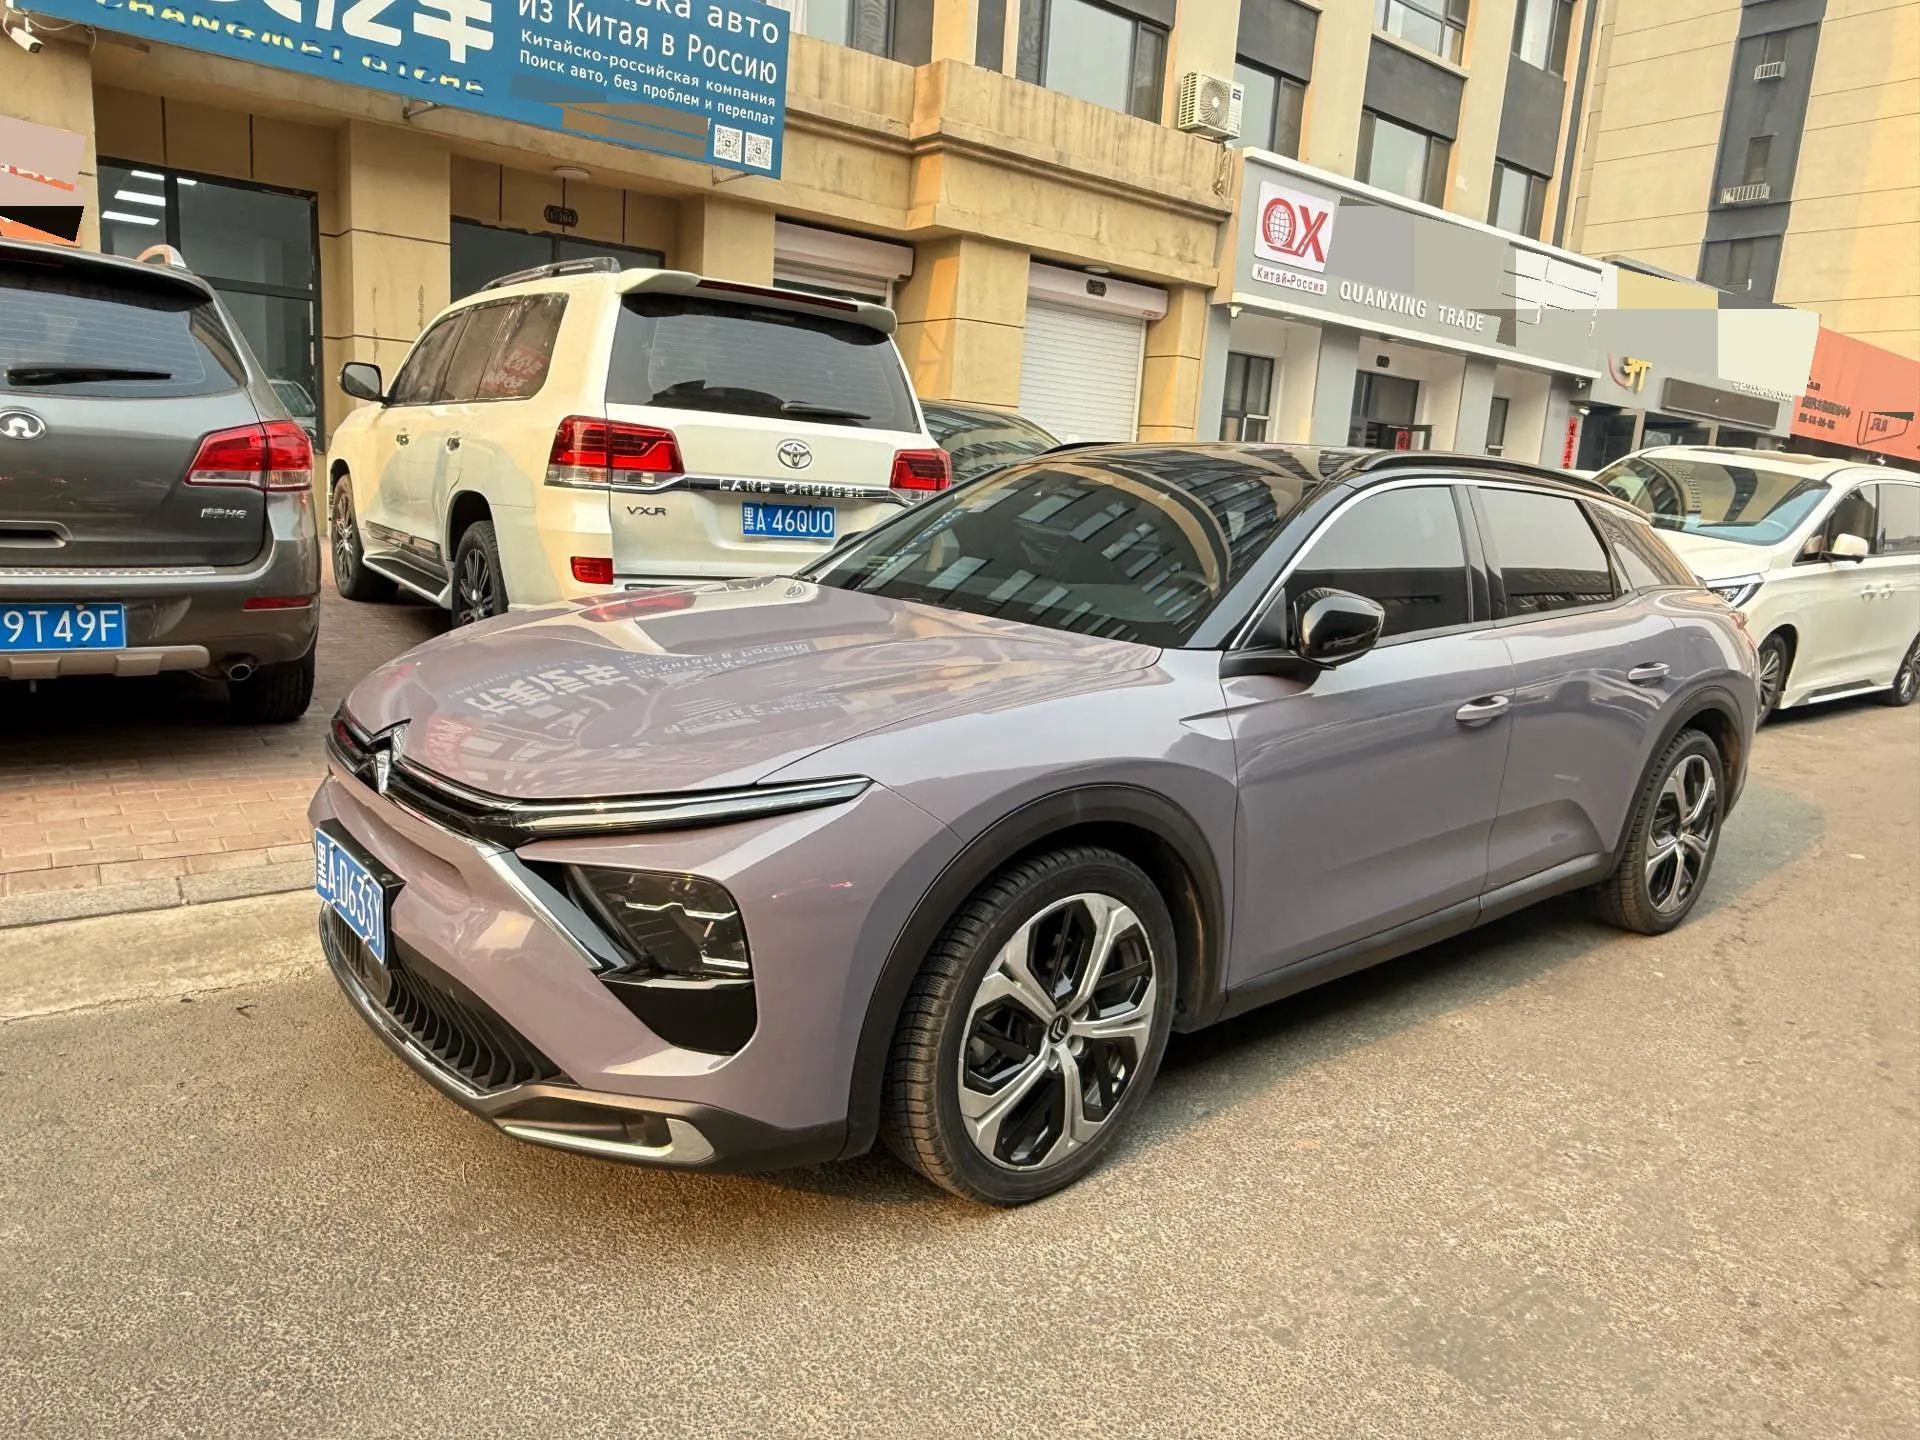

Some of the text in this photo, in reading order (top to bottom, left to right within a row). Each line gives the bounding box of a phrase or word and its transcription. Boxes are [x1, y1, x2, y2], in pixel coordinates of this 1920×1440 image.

[566, 0, 648, 50] Китая
[662, 33, 675, 56] в
[687, 33, 777, 84] Россию
[707, 5, 779, 44] авто
[361, 53, 485, 97] QICHE
[520, 49, 775, 126] Поиск авто, без проблем и переплат
[521, 29, 699, 87] Китайско-российская
[706, 80, 775, 107] компания
[1256, 266, 1325, 293] Китай-Россия
[1339, 281, 1484, 332] QUANXING TRADE
[719, 479, 771, 493] LAND
[3, 610, 119, 643] 9T49F
